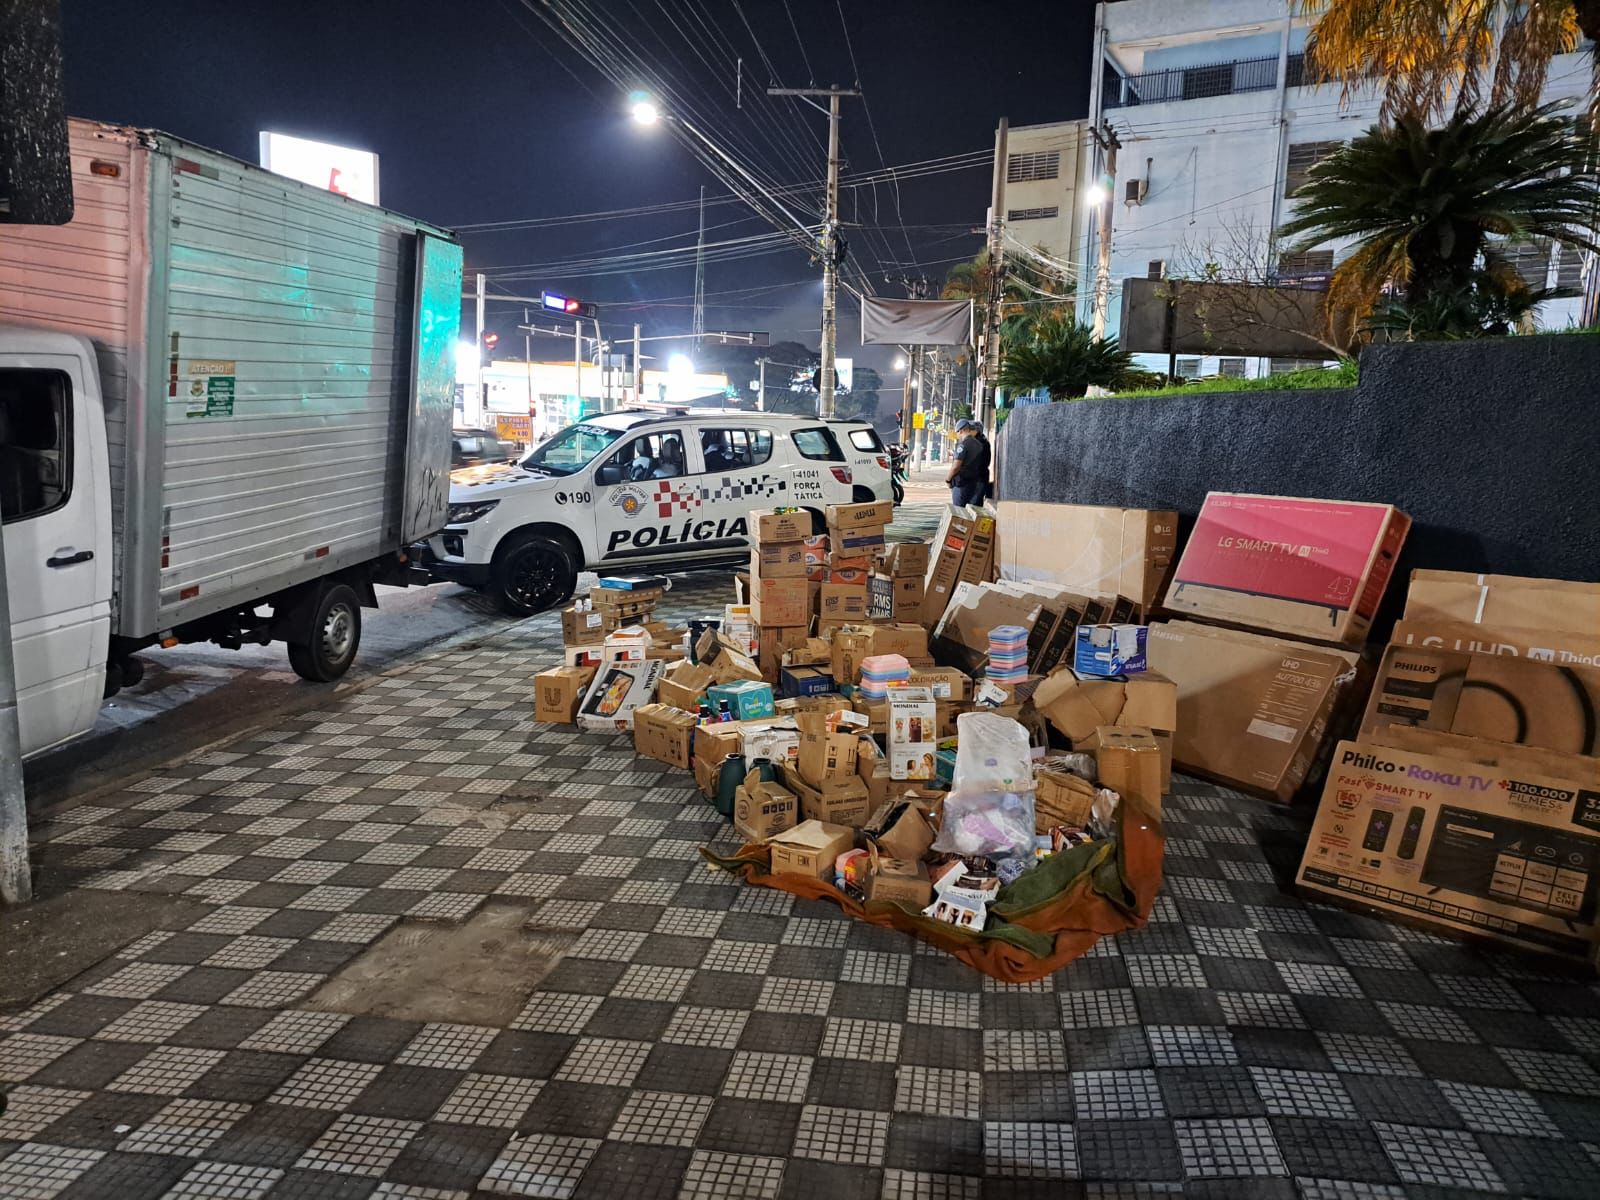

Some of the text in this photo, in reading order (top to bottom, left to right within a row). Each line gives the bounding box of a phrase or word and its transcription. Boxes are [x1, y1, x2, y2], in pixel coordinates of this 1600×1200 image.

[792, 470, 820, 479] I-41041
[794, 482, 821, 492] FORÇA
[568, 491, 591, 504] 190
[606, 517, 748, 552] POLÍCIA
[1217, 536, 1234, 548] LG
[1235, 538, 1279, 553] SMART
[1279, 543, 1298, 556] TV
[1327, 575, 1353, 596] 43
[873, 593, 891, 609] RMS
[1281, 659, 1300, 669] UHD
[1394, 661, 1437, 674] PHILIPS
[1341, 751, 1396, 773] Philco
[1467, 775, 1494, 792] TV
[1338, 775, 1433, 801] Fast SMART TV
[1508, 792, 1556, 809] FILMES
[1554, 896, 1577, 907] CINE
[1556, 890, 1578, 901] TELE
